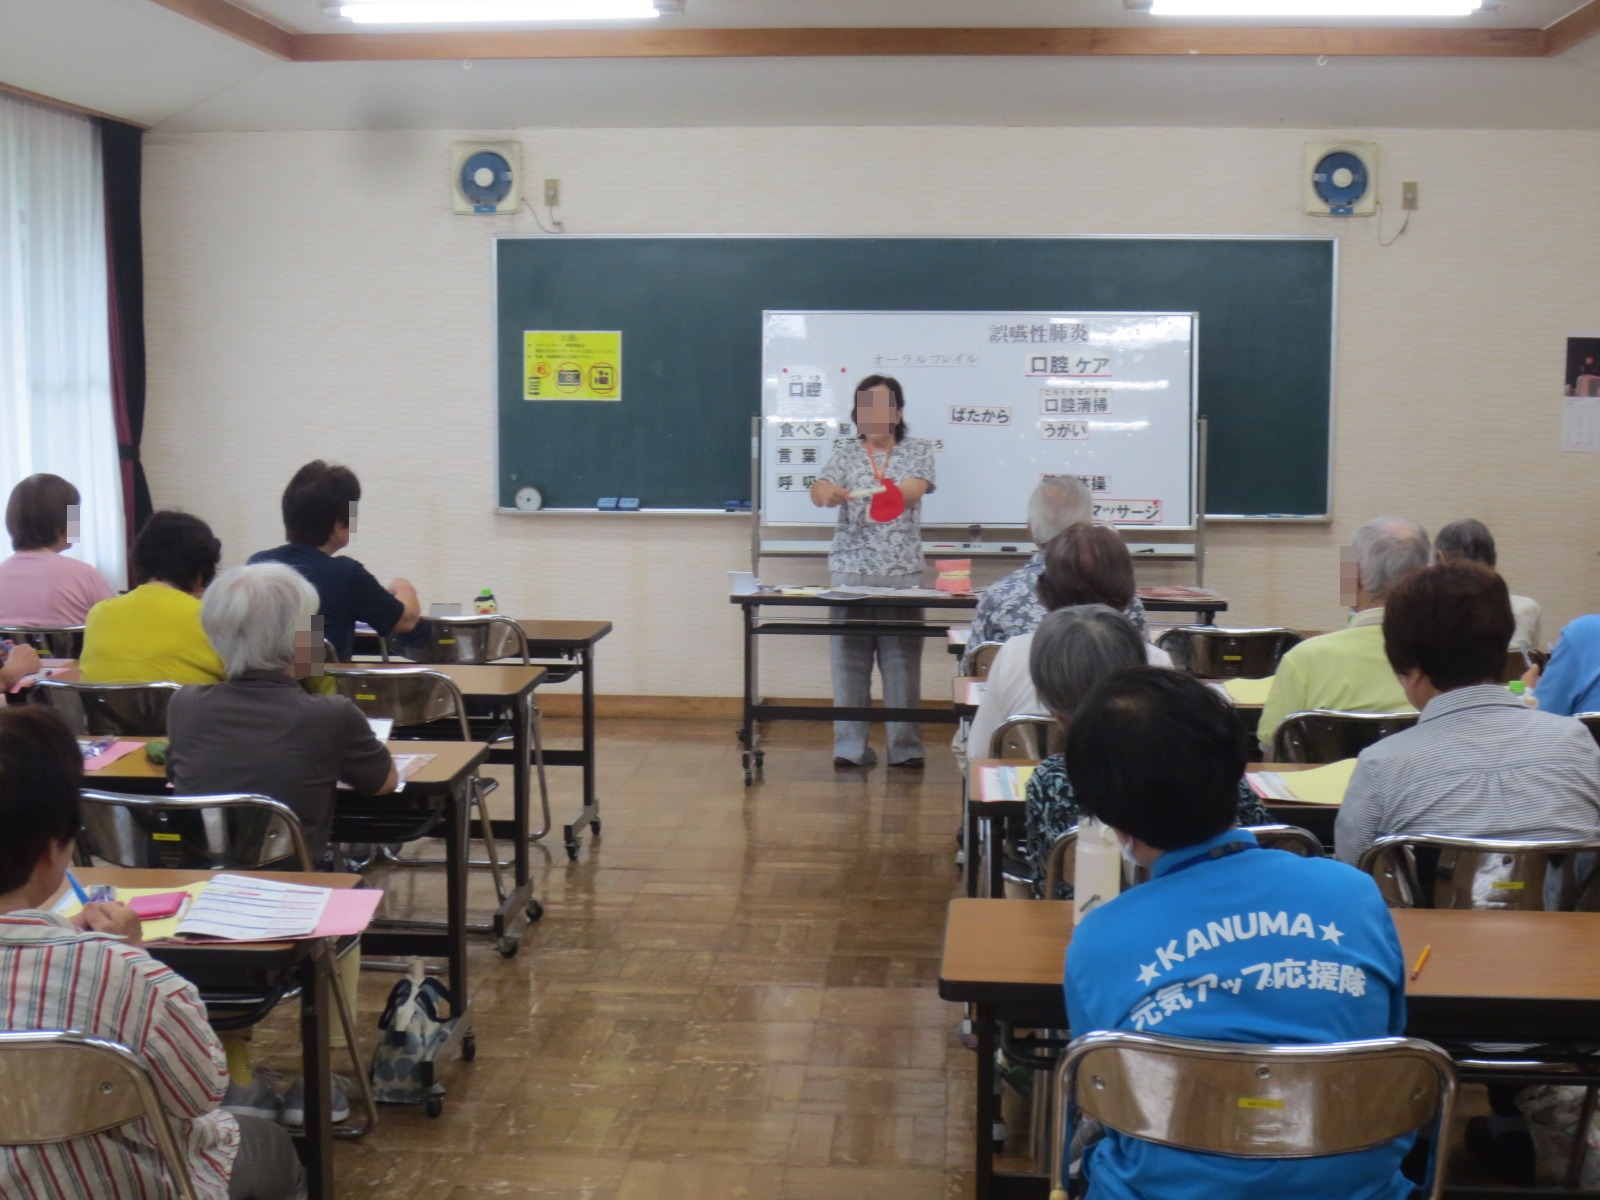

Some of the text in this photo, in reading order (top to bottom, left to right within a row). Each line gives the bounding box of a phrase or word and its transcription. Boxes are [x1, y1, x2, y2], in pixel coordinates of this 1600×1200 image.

[1045, 397, 1109, 413] 口腔清掃
[780, 422, 827, 438] 食べる
[1044, 423, 1087, 438] うがい
[777, 448, 817, 464] 言葉
[1155, 911, 1316, 971] KANUMA
[1130, 958, 1367, 1031] 元気アップ応援隊
